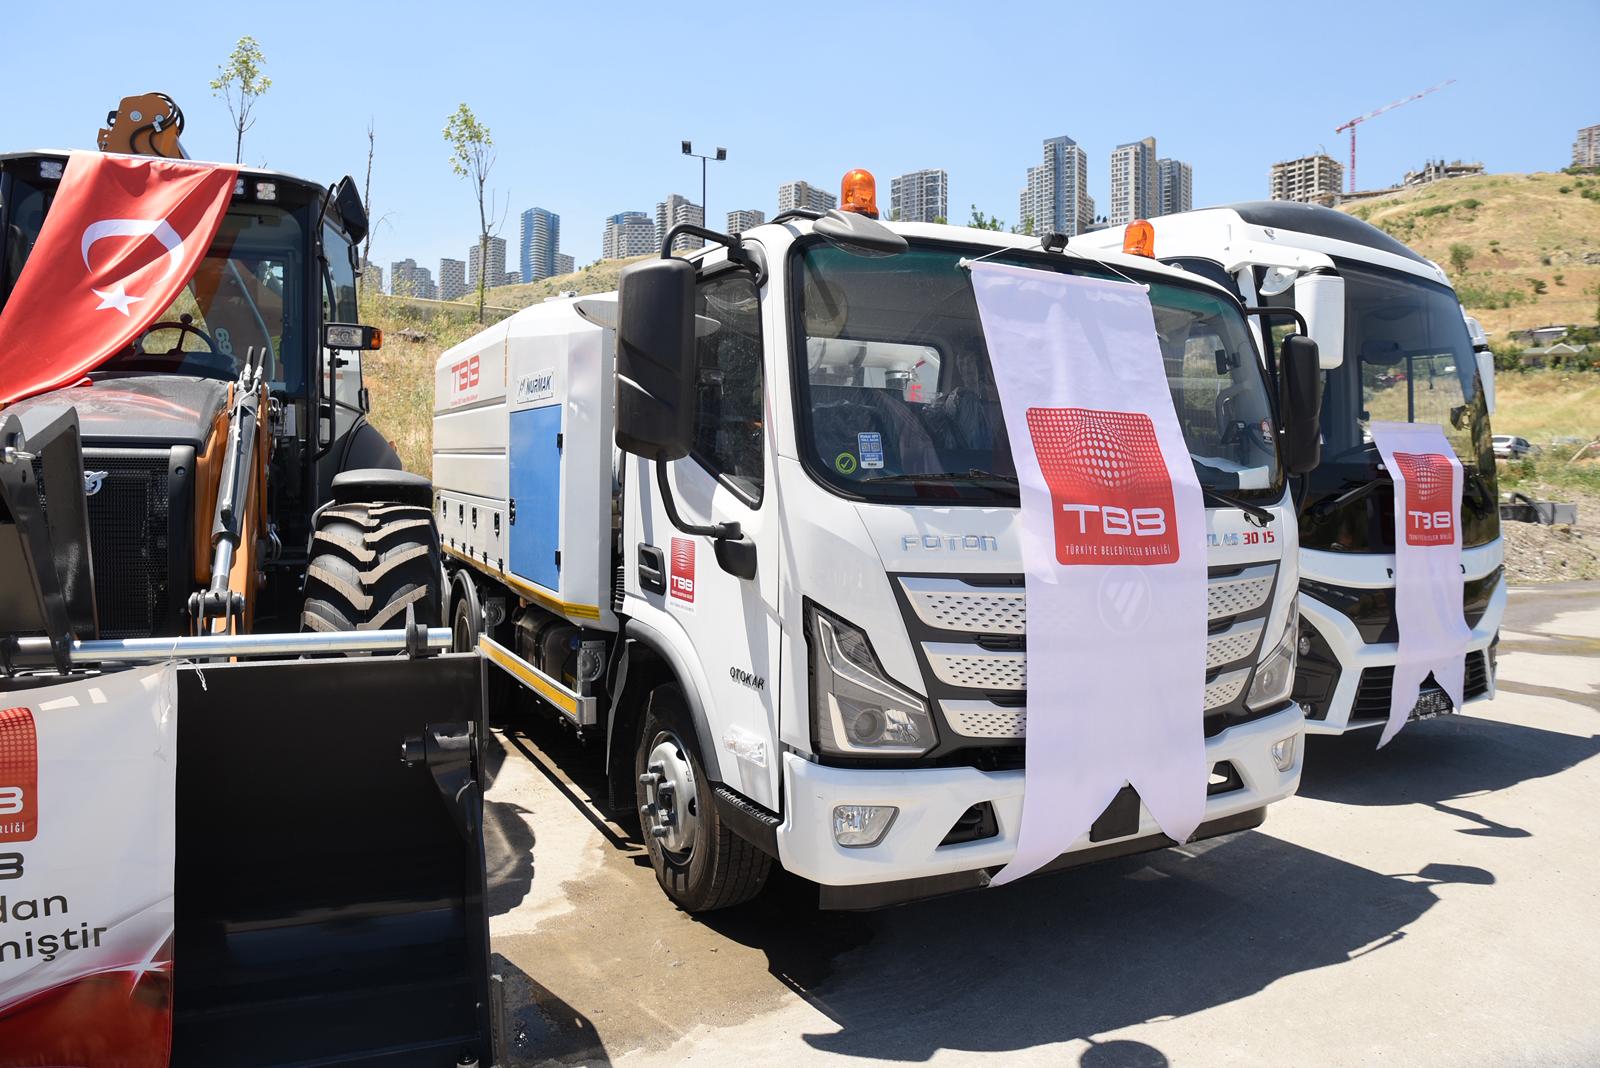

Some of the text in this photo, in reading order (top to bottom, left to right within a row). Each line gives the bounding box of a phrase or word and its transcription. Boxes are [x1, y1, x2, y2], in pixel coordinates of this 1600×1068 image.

[1062, 503, 1166, 536] TBB
[901, 535, 999, 551] FOTON
[1262, 531, 1275, 544] 15
[1065, 543, 1097, 556] TÜRKİYE
[671, 575, 693, 592] TBB
[729, 666, 765, 690] OTOKAR
